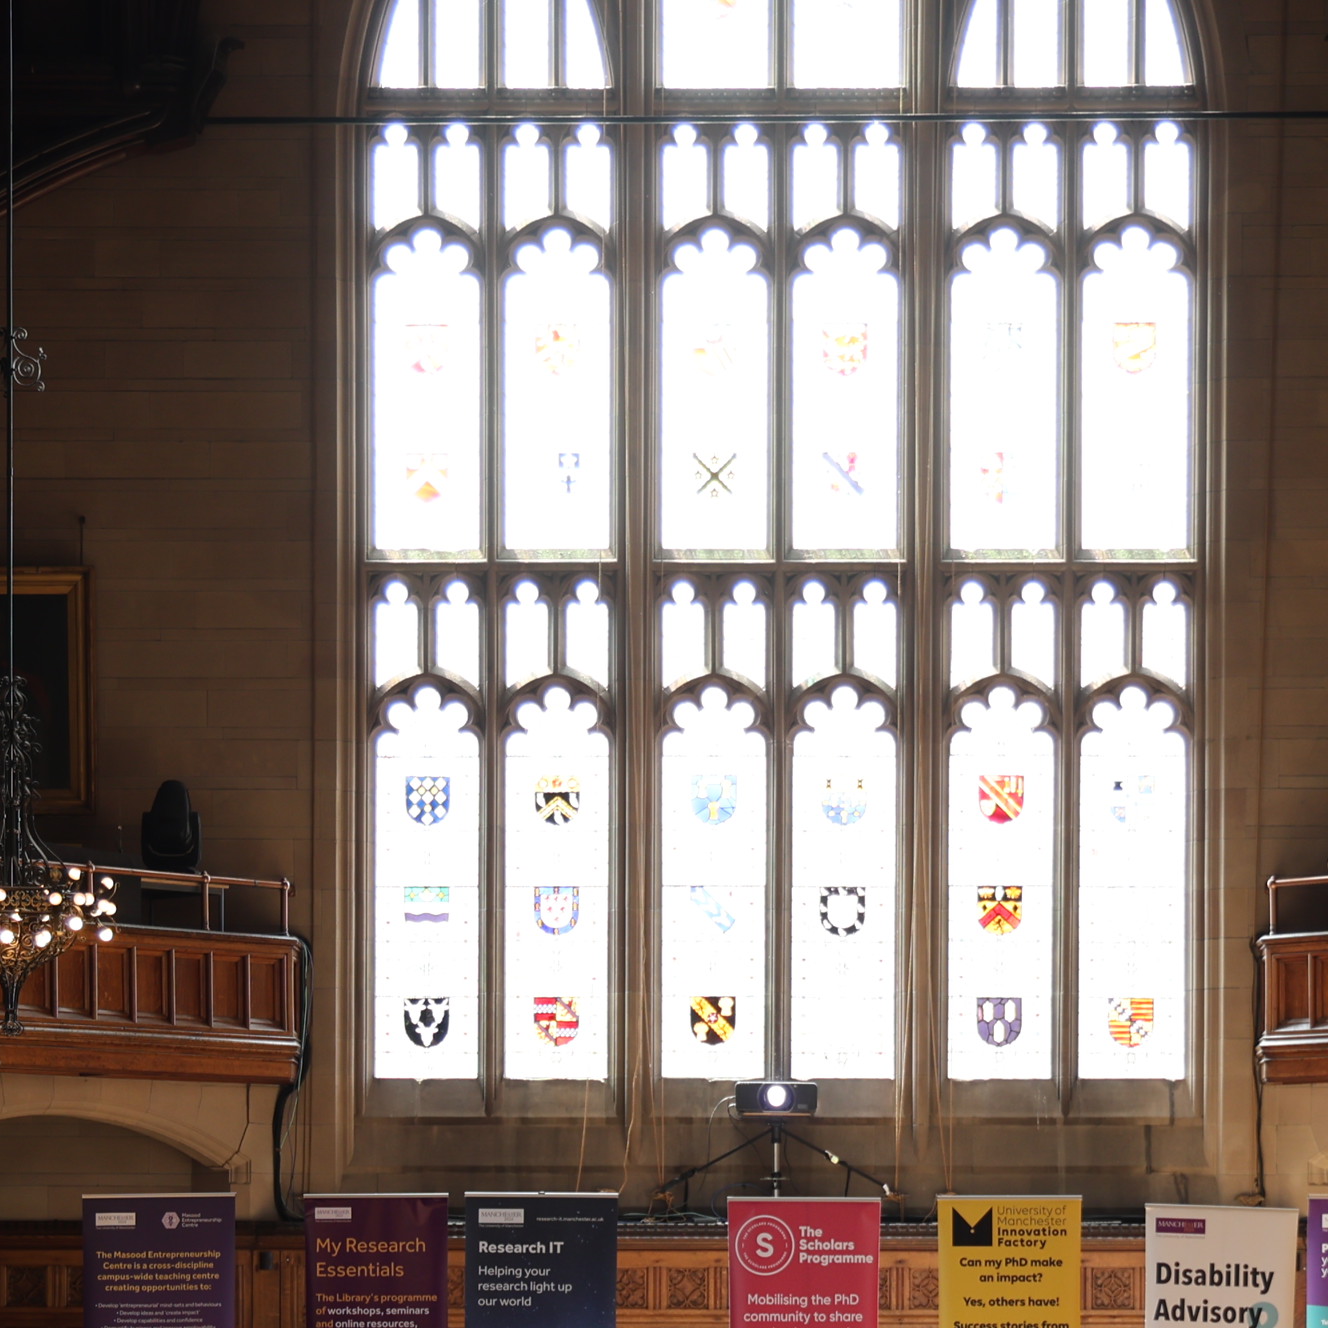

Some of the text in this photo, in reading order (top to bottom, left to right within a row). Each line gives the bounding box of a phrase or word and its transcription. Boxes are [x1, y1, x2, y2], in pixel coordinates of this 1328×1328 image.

[997, 1206, 1066, 1216] University of
[998, 1217, 1066, 1226] Manchester
[799, 1226, 822, 1237] The
[998, 1227, 1067, 1236] Innovation
[316, 1237, 425, 1257] My Research
[479, 1241, 564, 1253] Research IT
[756, 1233, 774, 1257] S
[799, 1239, 854, 1250] Scholars
[998, 1238, 1046, 1249] Factory
[148, 1250, 220, 1259] Entrepreneurship
[799, 1253, 873, 1266] Programme
[149, 1262, 213, 1270] cross-discipline
[960, 1257, 1063, 1269] Can my PhD make
[316, 1262, 404, 1277] Essentials
[478, 1266, 551, 1278] Helping your
[97, 1273, 153, 1281] campus-wide
[155, 1273, 190, 1281] teaching
[997, 1273, 1042, 1284] impact?
[1156, 1262, 1274, 1294] Disability
[105, 1284, 140, 1292] creating
[142, 1284, 198, 1292] opportunities
[478, 1282, 572, 1293] research light up
[316, 1293, 437, 1304] The Library's programme
[478, 1297, 532, 1306] our world
[748, 1294, 859, 1308] Mobilising the PhD
[963, 1297, 1059, 1307] Yes, others have!
[316, 1306, 429, 1316] of workshops, seminars
[744, 1311, 862, 1324] community to share
[316, 1320, 333, 1328] and
[335, 1320, 365, 1328] online
